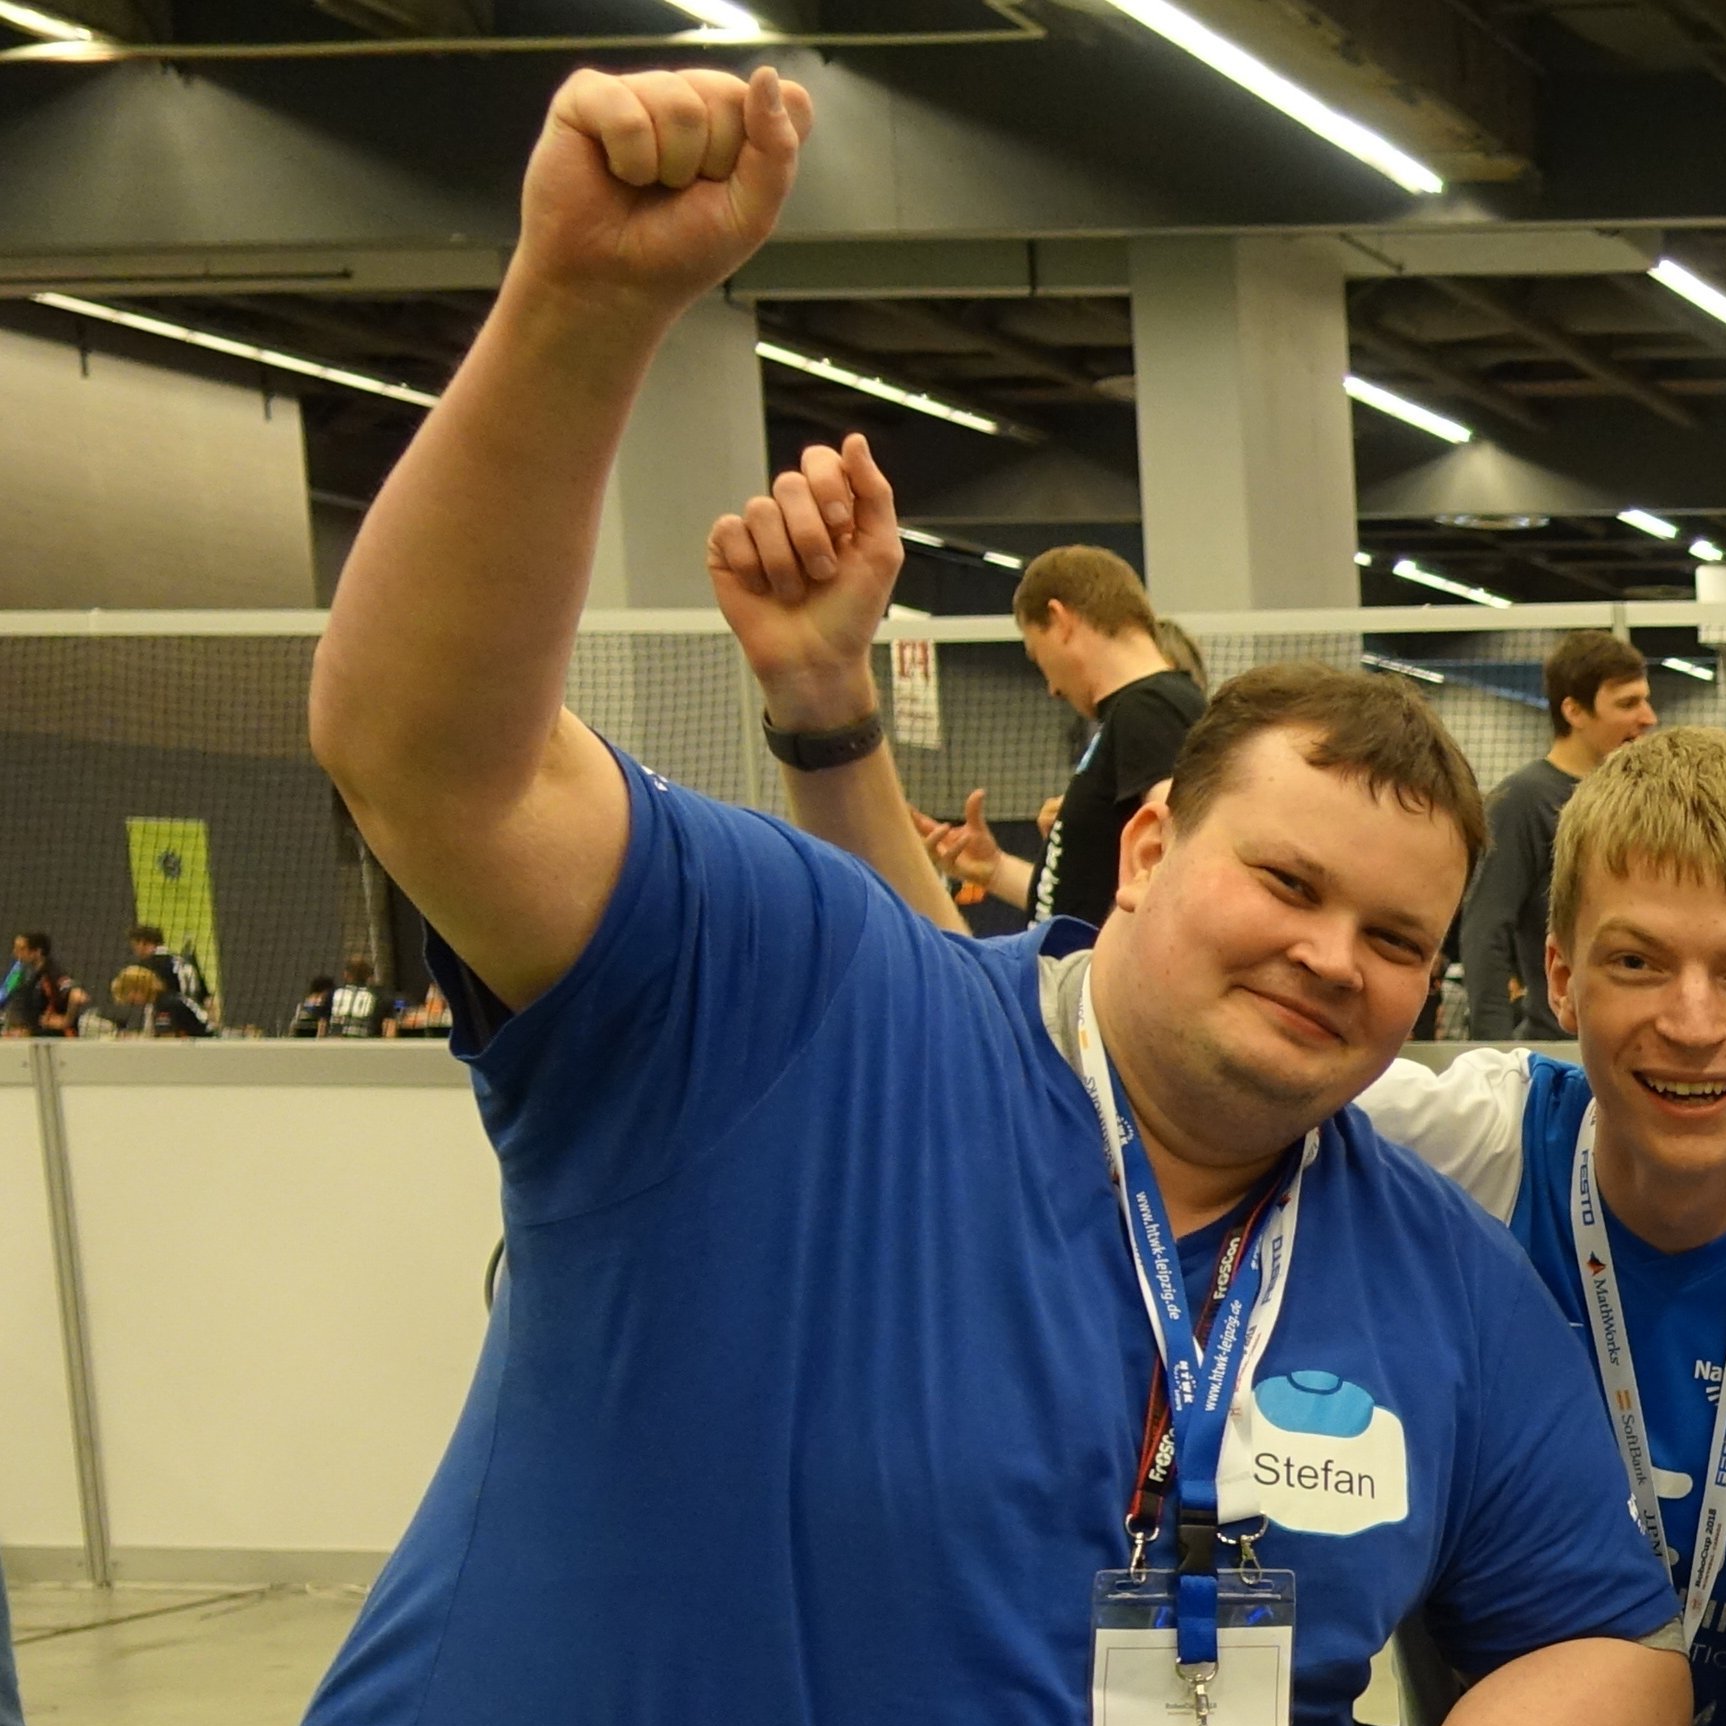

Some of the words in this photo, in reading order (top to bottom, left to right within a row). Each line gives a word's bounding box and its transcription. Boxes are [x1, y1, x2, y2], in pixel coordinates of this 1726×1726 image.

[1579, 1149, 1596, 1227] FESTO
[1136, 1191, 1180, 1321] www.htwk-leipzig.de
[1205, 1300, 1243, 1412] www.htwk-leipzig.de
[1593, 1277, 1620, 1367] MathWorks
[1253, 1452, 1375, 1499] Stefan
[1621, 1413, 1647, 1487] SoftBank
[1695, 1539, 1713, 1588] RoboCup
[1705, 1508, 1717, 1535] 2018
